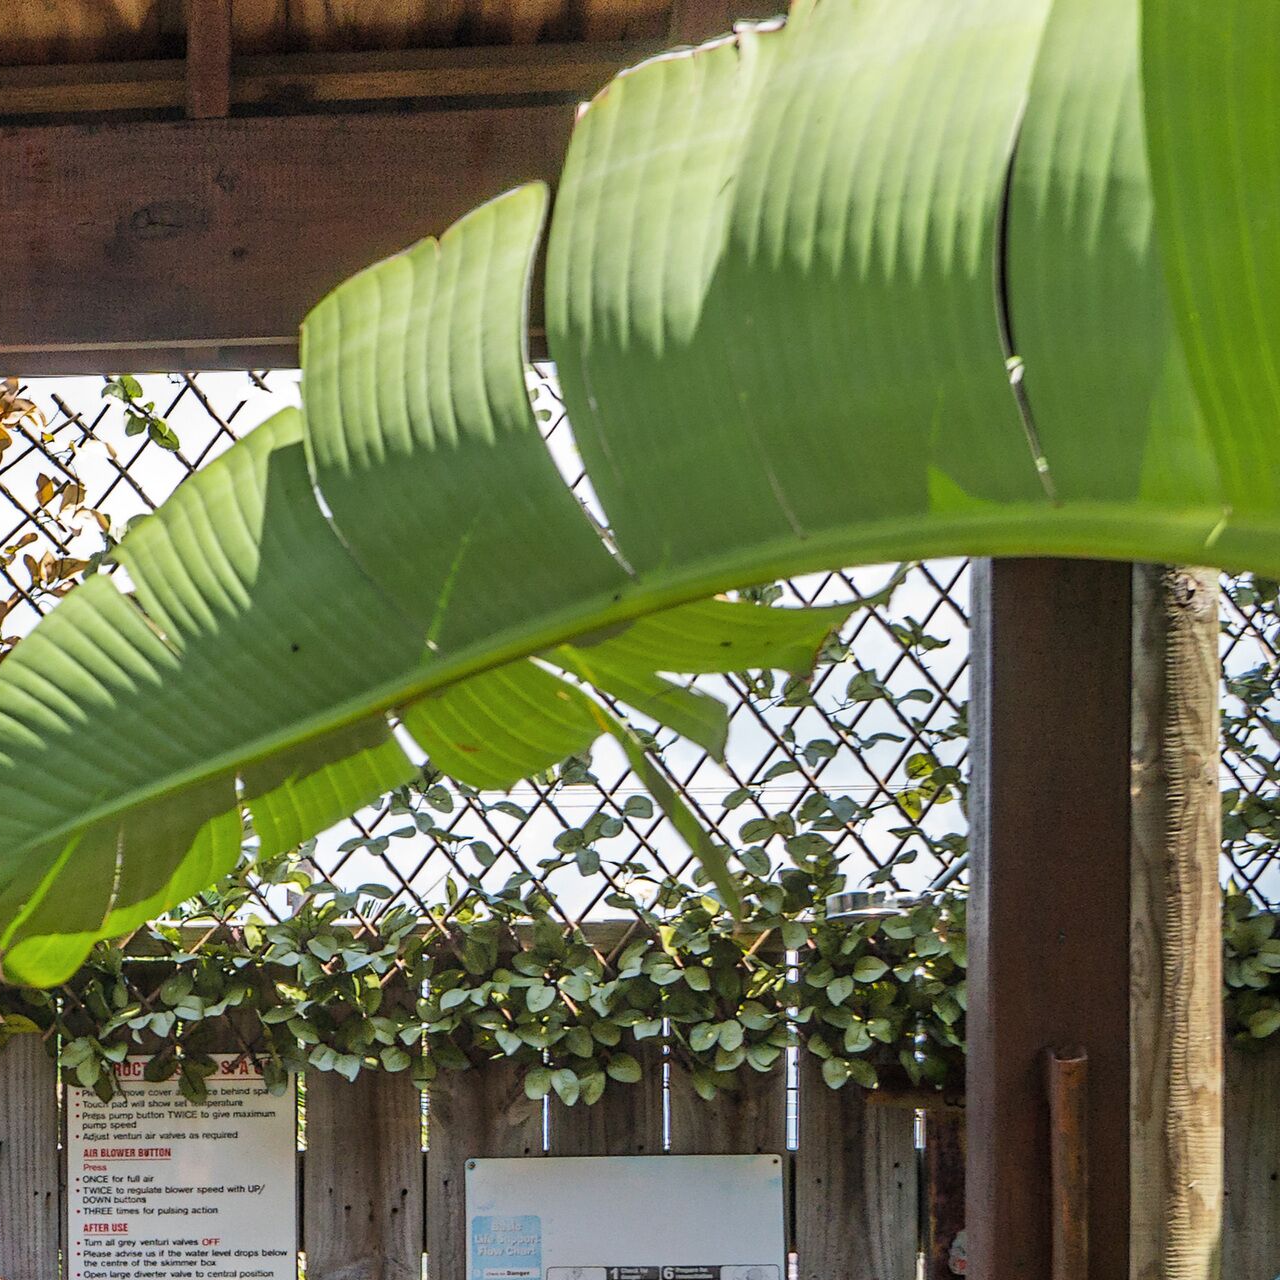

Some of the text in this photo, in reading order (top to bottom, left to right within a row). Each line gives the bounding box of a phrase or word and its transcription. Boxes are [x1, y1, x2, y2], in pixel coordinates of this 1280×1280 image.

[221, 1088, 249, 1096] behind
[111, 1100, 128, 1109] pad
[131, 1100, 145, 1108] will
[149, 1099, 170, 1108] show
[82, 1112, 106, 1120] Press
[168, 1110, 197, 1119] TWICE
[212, 1110, 230, 1119] give
[82, 1120, 136, 1130] pump speed
[83, 1133, 109, 1141] Adjust
[202, 1131, 238, 1140] required
[84, 1148, 171, 1157] AIR BLOWER BUTTON
[83, 1175, 108, 1183] ONCE
[84, 1186, 112, 1194] TWICE
[127, 1187, 162, 1195] regulate
[197, 1186, 224, 1194] speed
[248, 1184, 265, 1194] UP/
[83, 1196, 111, 1204] DOWN
[83, 1207, 112, 1215] THREE
[158, 1207, 188, 1216] pulsing
[84, 1223, 128, 1232] AFTER USE
[202, 1238, 220, 1246] OFF
[234, 1250, 259, 1258] drops
[84, 1271, 107, 1279] Open
[110, 1271, 131, 1279] large
[240, 1270, 274, 1278] position
[610, 1268, 619, 1280] 1
[663, 1267, 674, 1280] 6
